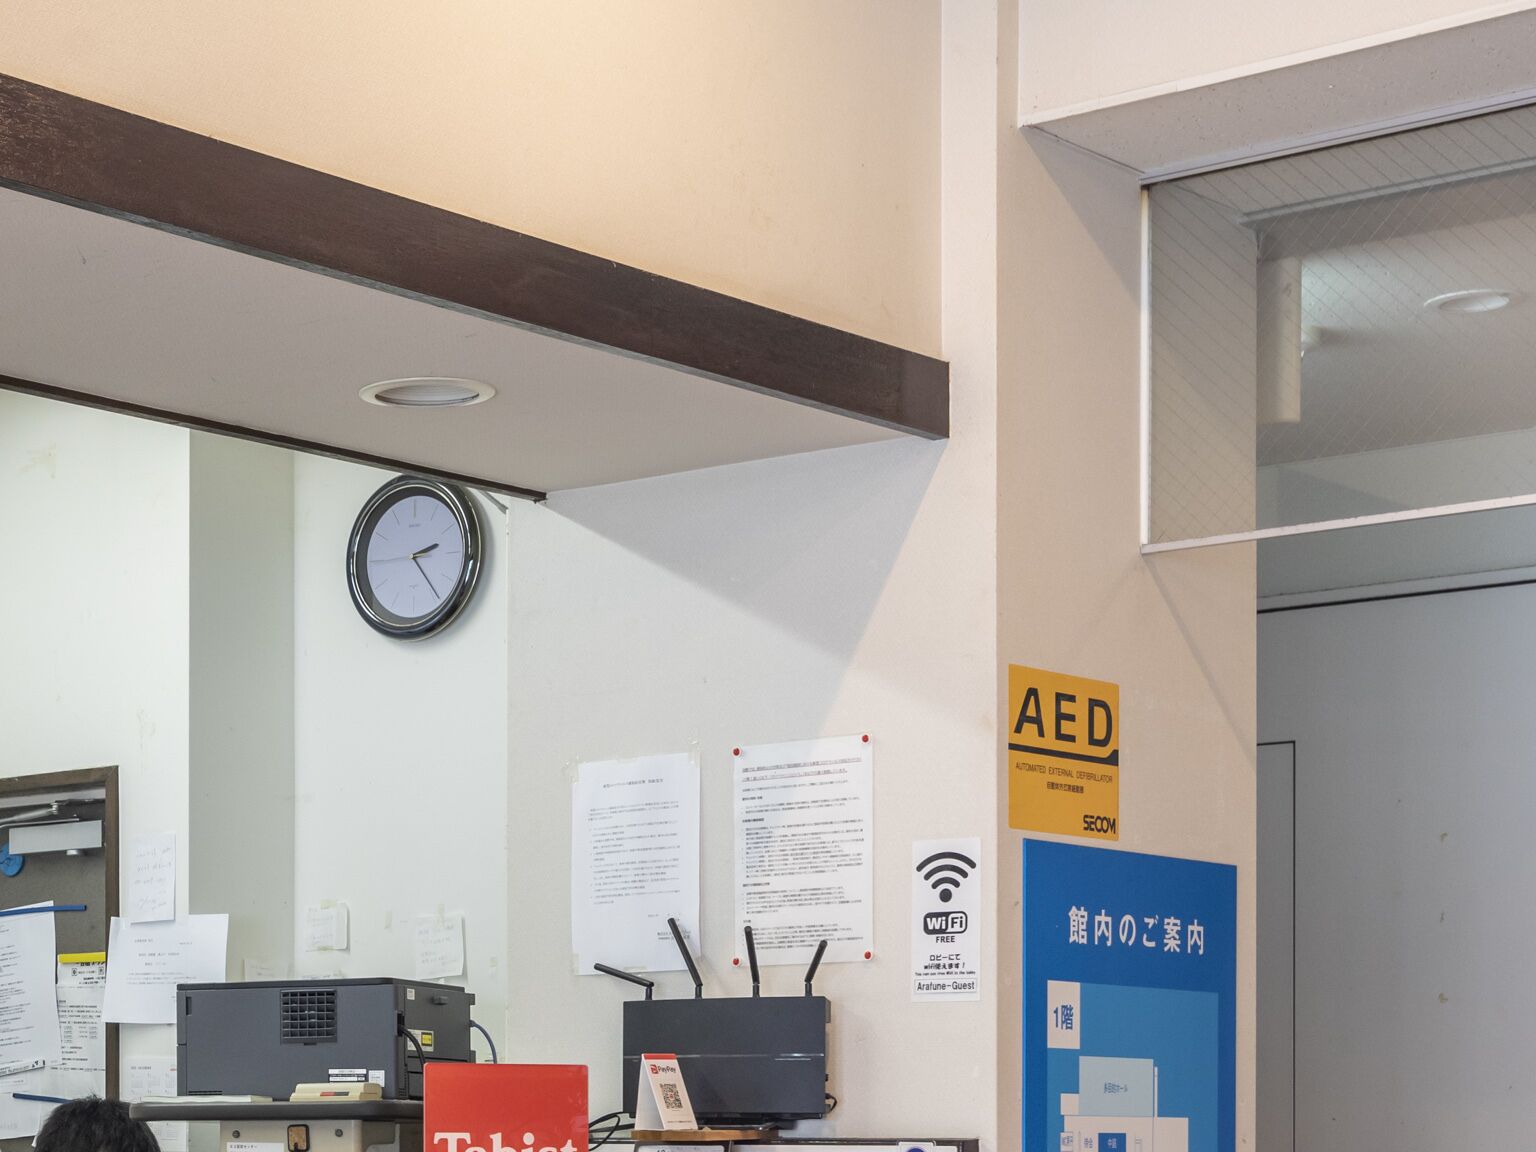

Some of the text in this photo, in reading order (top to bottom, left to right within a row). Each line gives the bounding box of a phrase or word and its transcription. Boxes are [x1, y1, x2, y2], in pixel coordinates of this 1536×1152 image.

[1014, 687, 1113, 748] AED
[1016, 762, 1113, 784] AUTOMATED EXTERNAL DEFIBRILLATOR
[1083, 815, 1116, 834] SECOM
[1068, 905, 1204, 956] 館内のご案内
[917, 981, 975, 991] Arafune-Guest
[1053, 1004, 1074, 1030] 1階
[658, 1065, 676, 1073] PayPay
